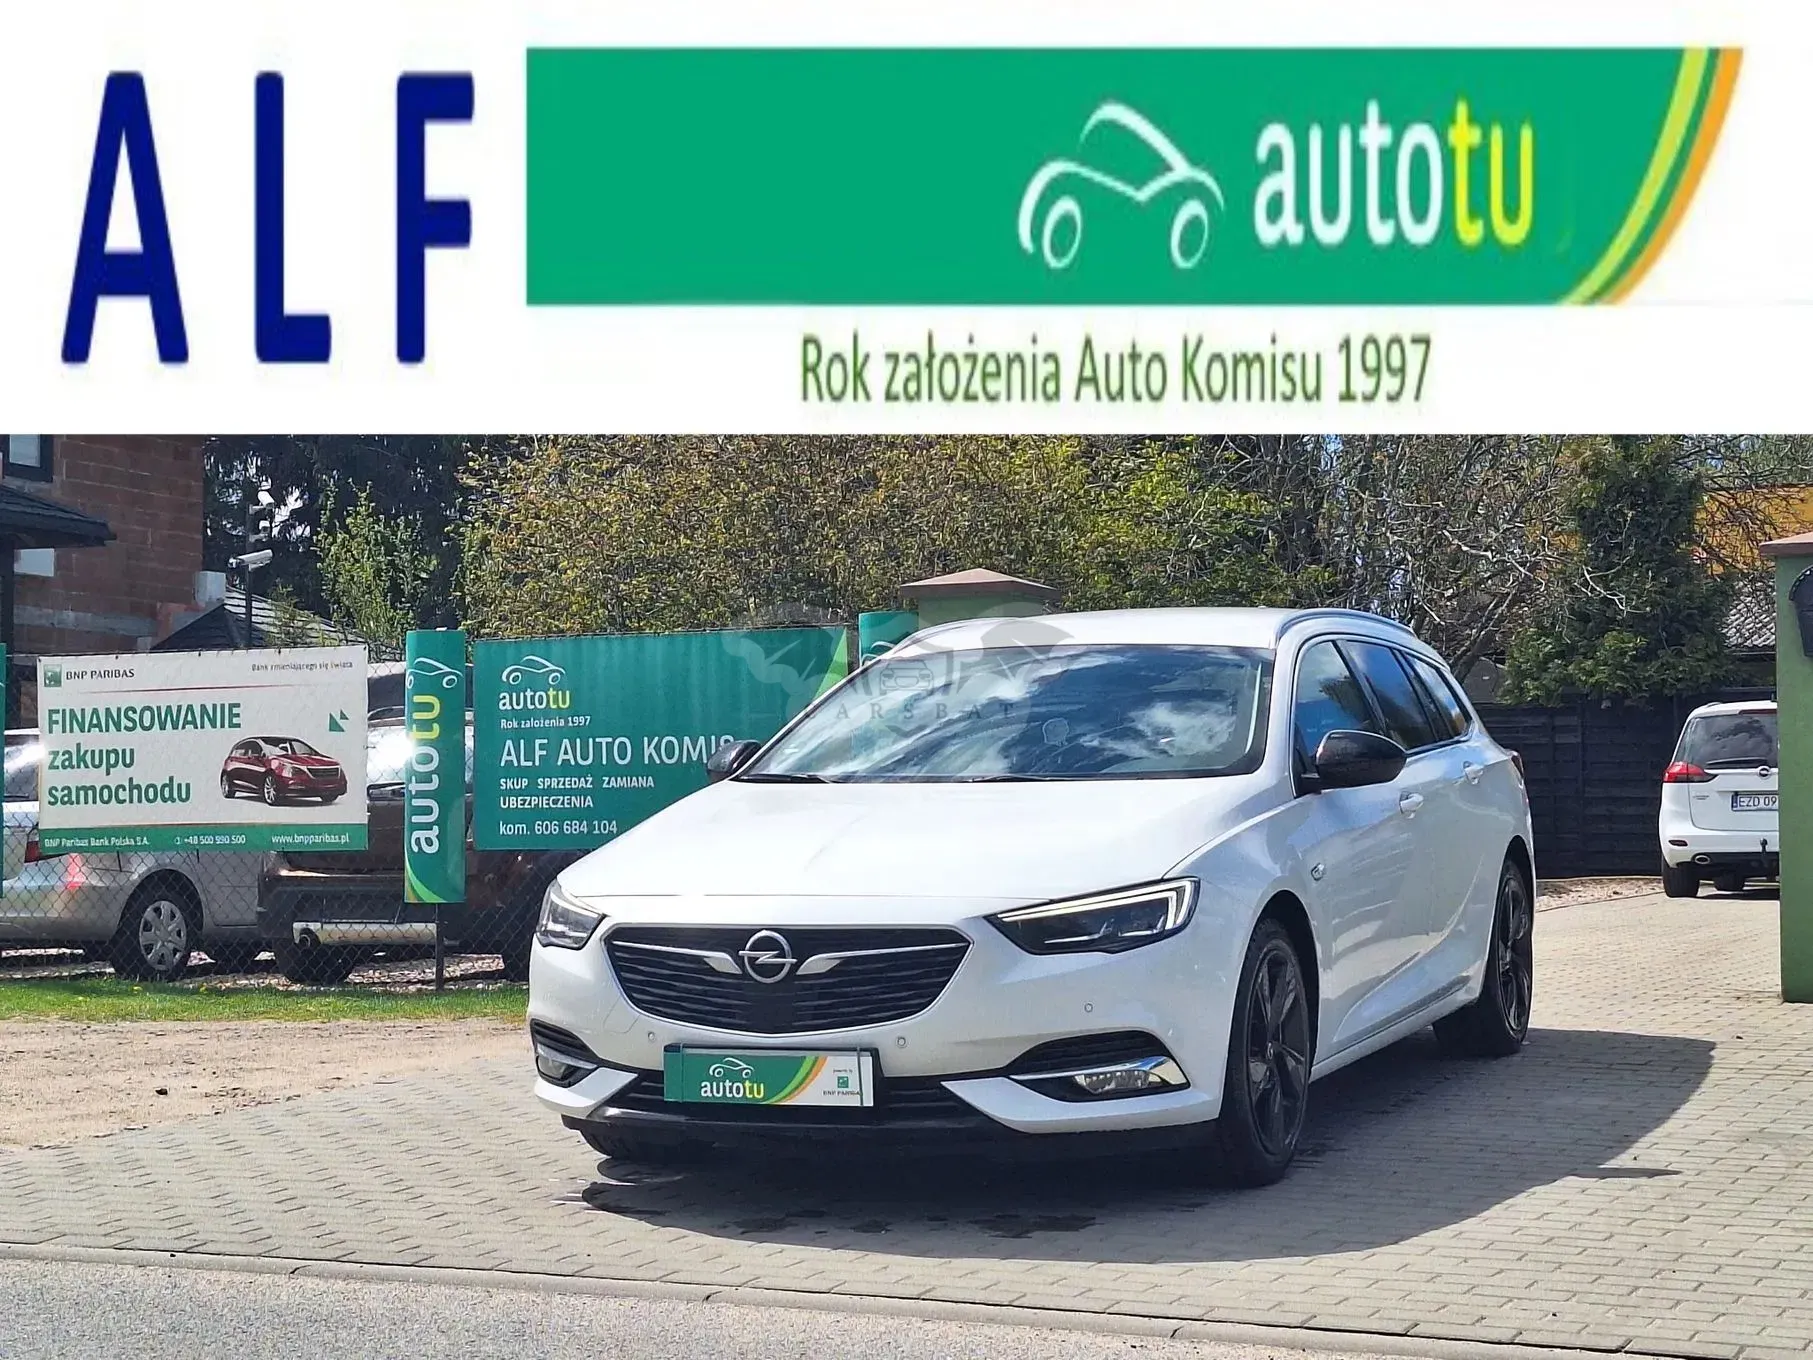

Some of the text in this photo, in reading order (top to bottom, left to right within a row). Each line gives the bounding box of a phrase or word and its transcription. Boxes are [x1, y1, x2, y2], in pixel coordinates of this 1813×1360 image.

[65, 668, 135, 681] BNP PARIBAS
[498, 687, 570, 710] autotu
[47, 702, 242, 735] FINANSOWANIE
[500, 719, 518, 729] Rok
[567, 715, 591, 727] 1997
[47, 743, 135, 776] zakupu
[500, 738, 548, 767] ALF
[557, 736, 632, 766] AUTO
[409, 695, 440, 854] autotu
[500, 773, 655, 790] SKUP SPRZEDAŻ ZAMIANA
[47, 776, 191, 806] samochodu
[500, 795, 594, 809] UBEZPIECZENIA
[1739, 796, 1760, 807] EZD
[499, 820, 618, 835] kom. 606 684 104
[44, 839, 60, 847] BNP
[90, 837, 109, 846] Bank
[271, 833, 350, 845] www.bnpparibas.pl
[701, 1081, 764, 1099] autotu
